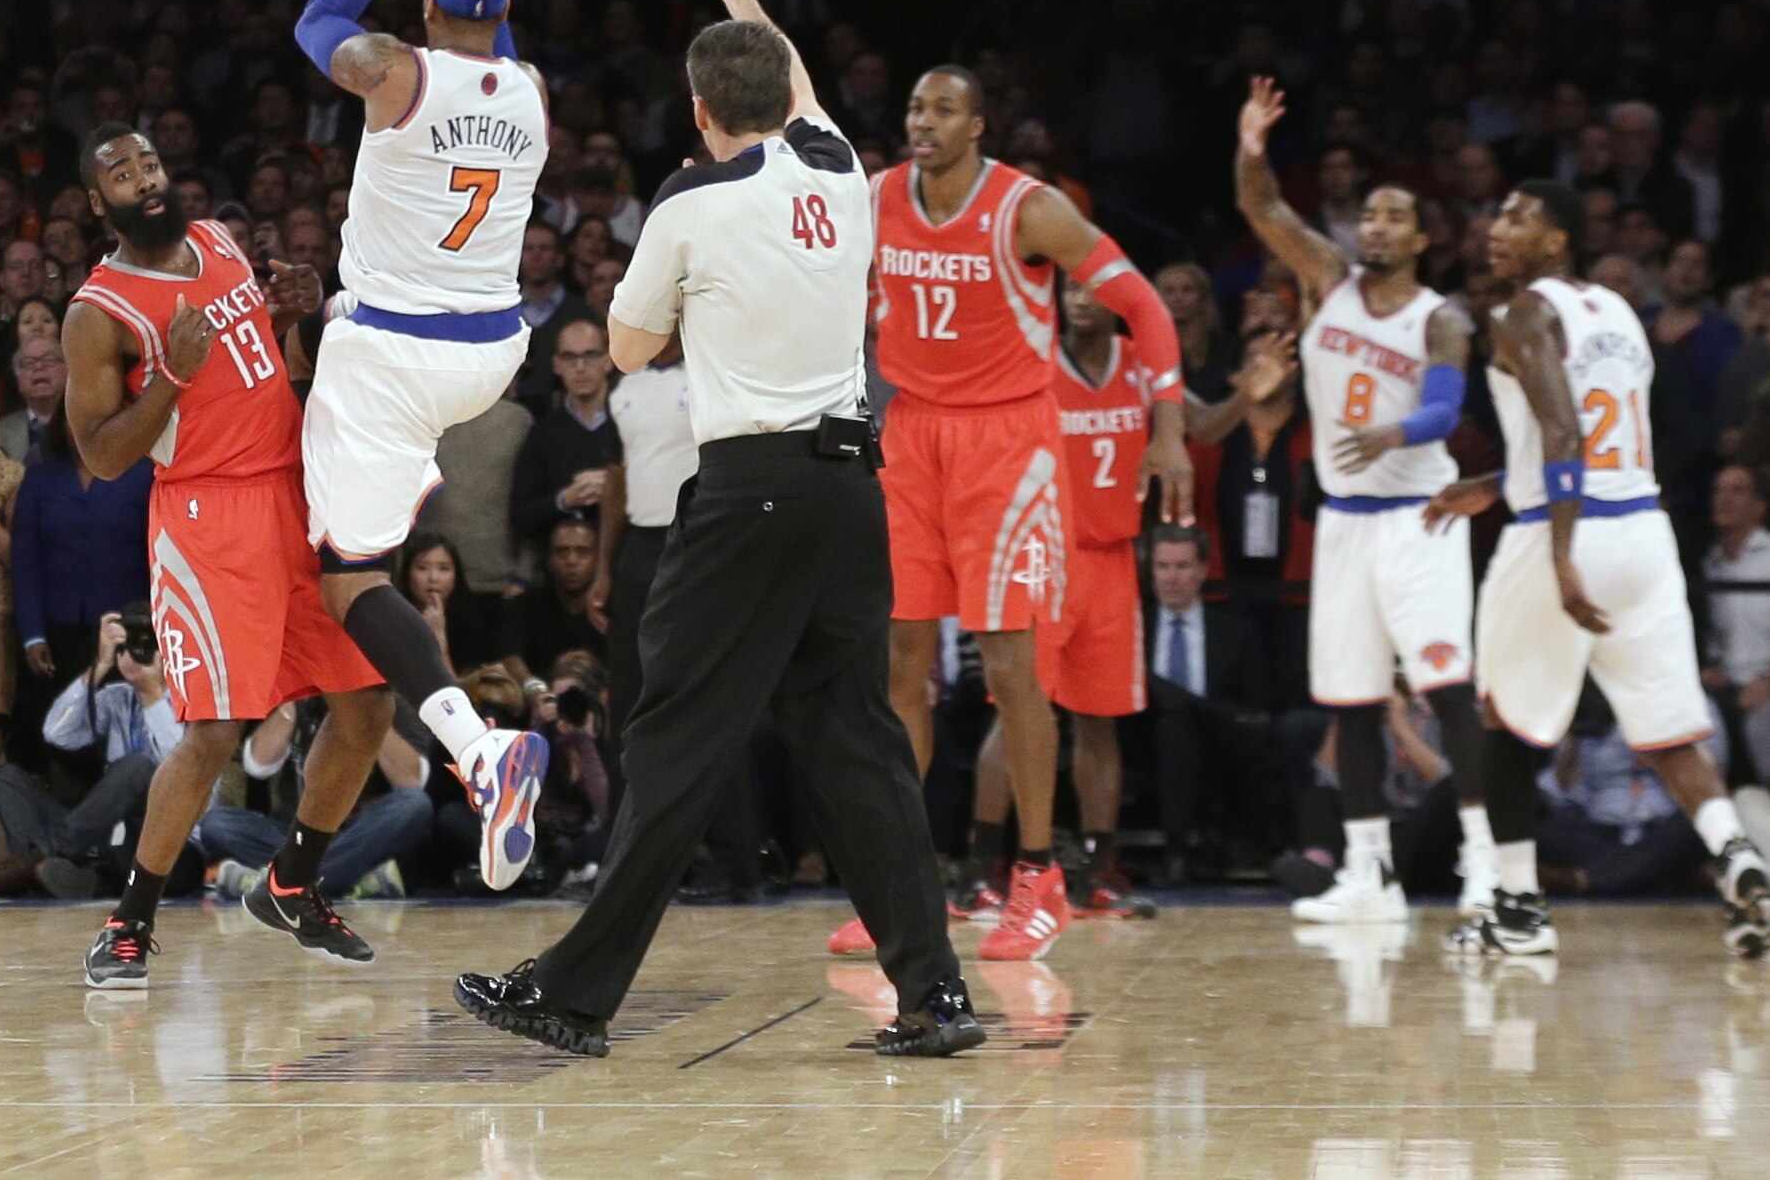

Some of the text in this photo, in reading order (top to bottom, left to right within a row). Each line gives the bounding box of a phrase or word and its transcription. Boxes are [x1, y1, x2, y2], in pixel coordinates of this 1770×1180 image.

[430, 115, 532, 161] ANTHONY
[437, 165, 502, 252] 7
[792, 193, 836, 250] 48
[880, 244, 992, 282] ROCKETS
[910, 283, 959, 340] 12
[220, 319, 276, 389] 13
[1344, 372, 1376, 424] 8
[1580, 387, 1648, 470] 21
[1091, 437, 1118, 489] 2
